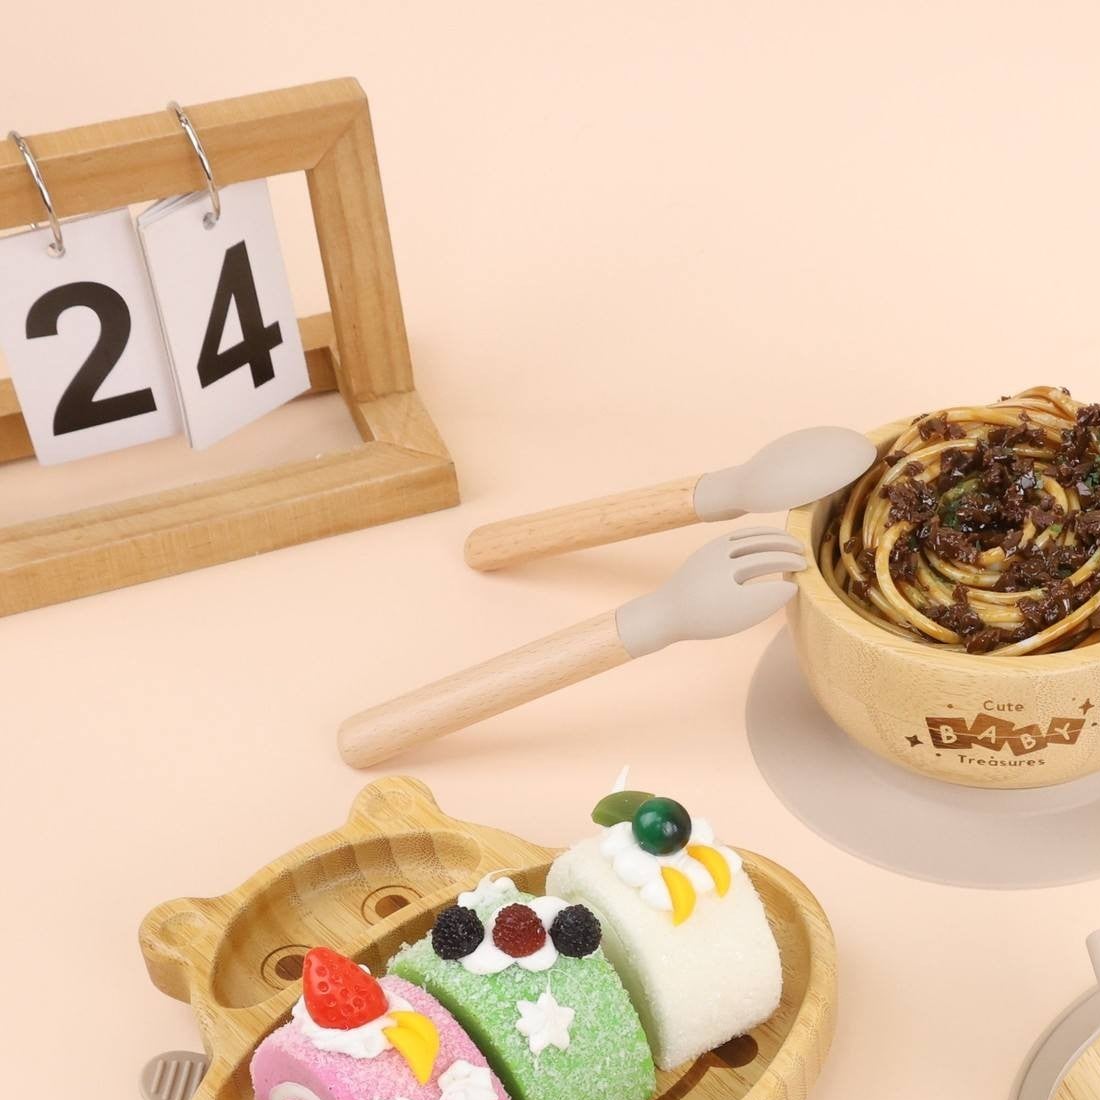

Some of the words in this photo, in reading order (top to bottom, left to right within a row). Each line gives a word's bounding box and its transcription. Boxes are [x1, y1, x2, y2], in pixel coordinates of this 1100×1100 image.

[26, 281, 158, 437] 2
[197, 240, 284, 390] 4
[983, 700, 1025, 713] Cute
[936, 720, 1073, 750] BABY
[958, 754, 1046, 767] Treasures
